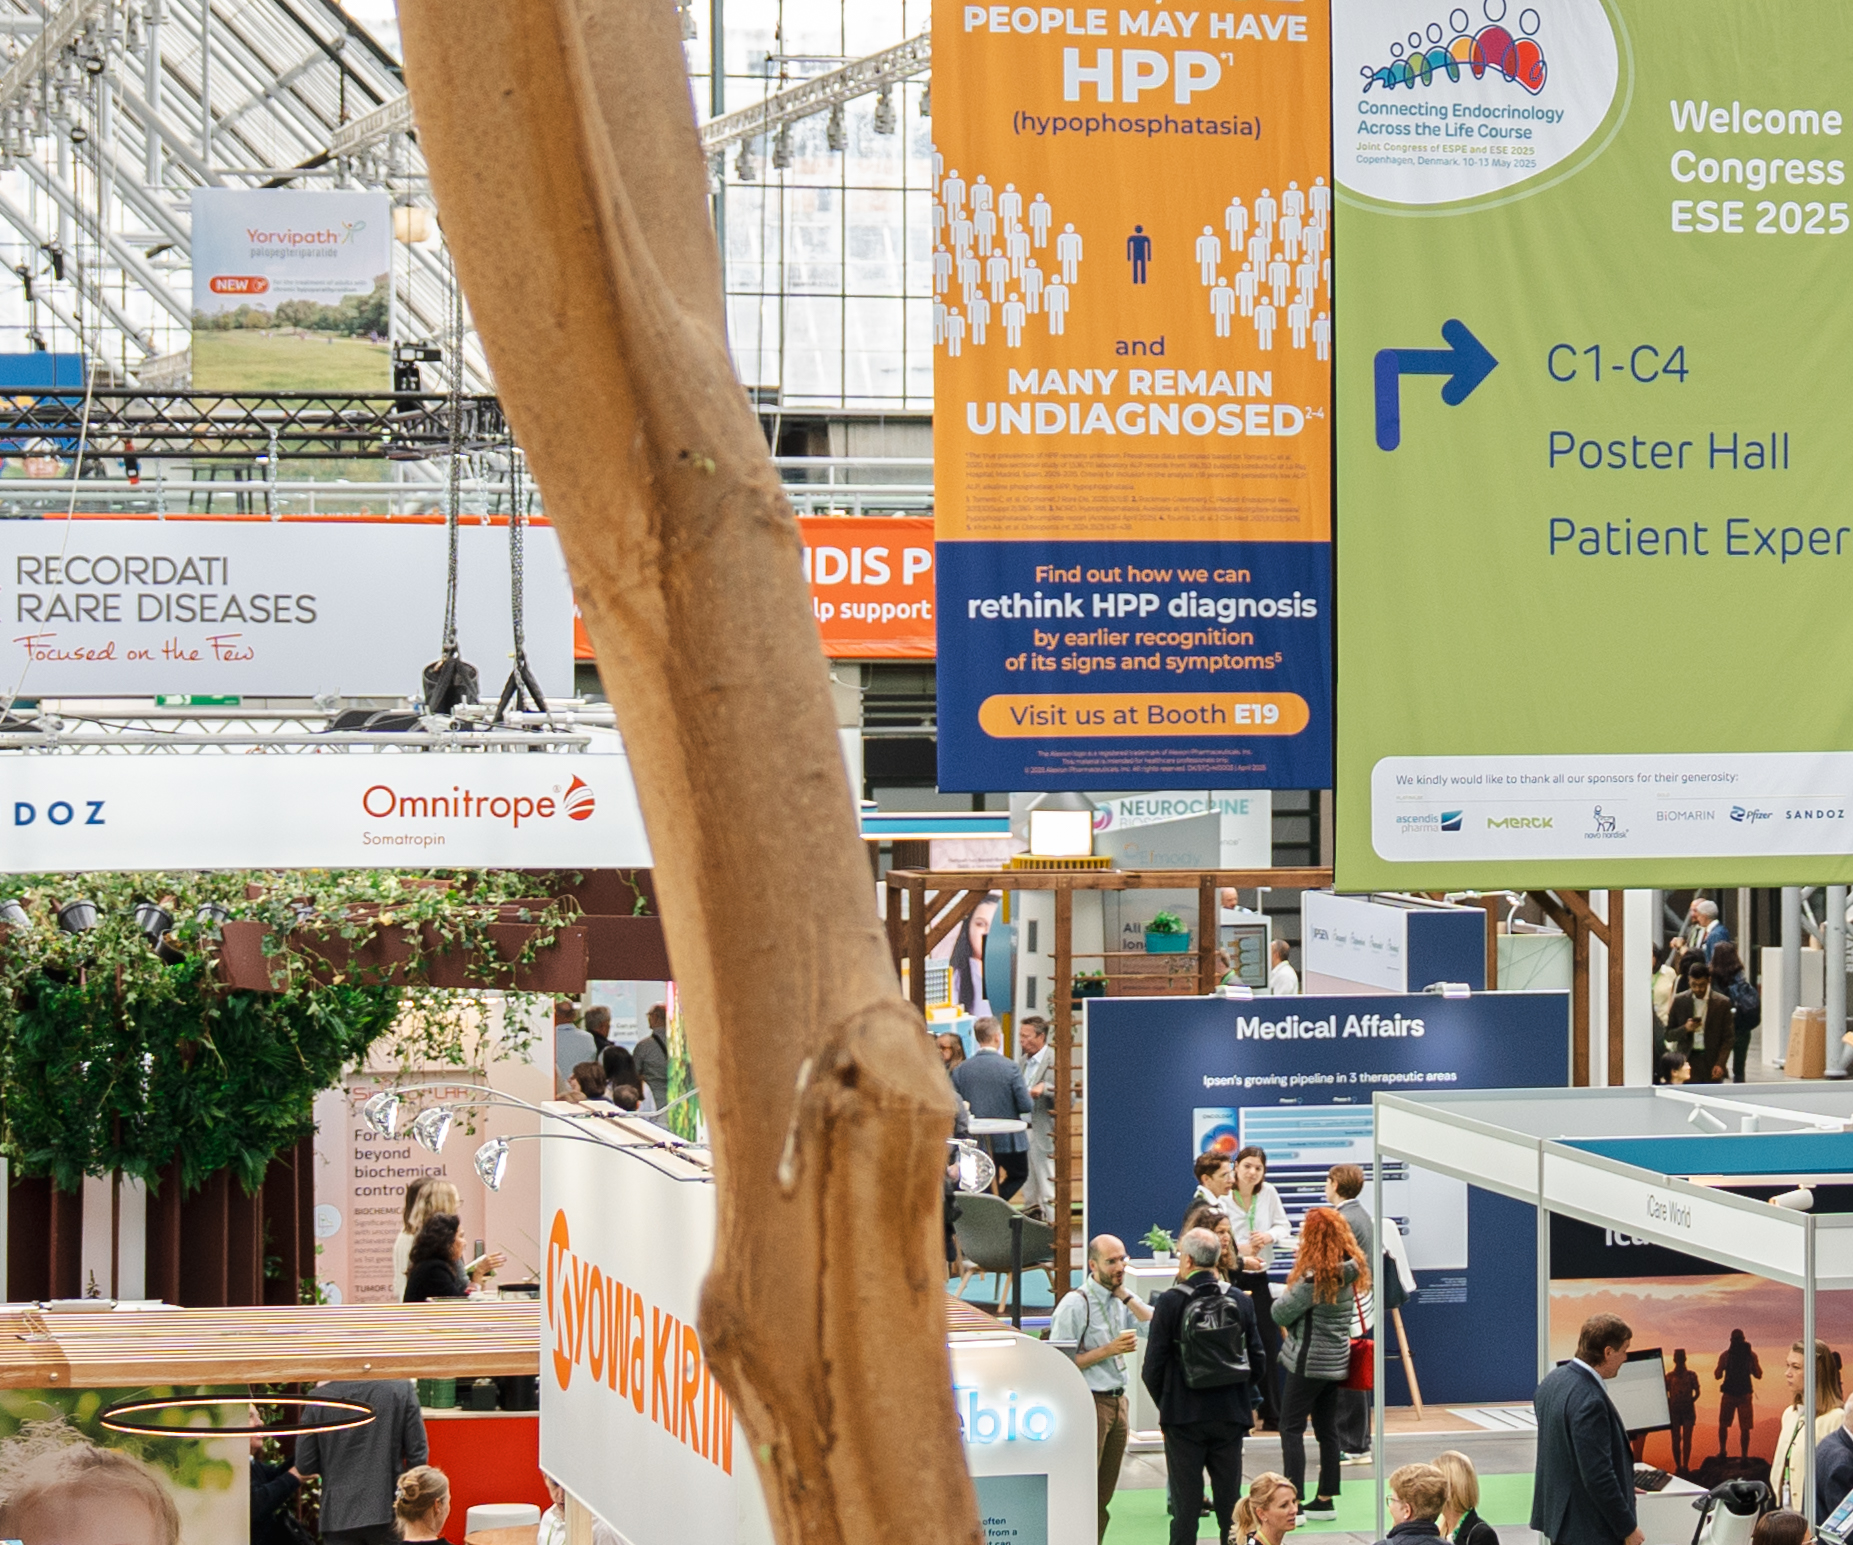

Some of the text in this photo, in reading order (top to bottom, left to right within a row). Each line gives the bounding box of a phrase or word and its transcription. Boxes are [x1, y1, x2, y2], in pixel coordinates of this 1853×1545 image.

[964, 6, 1308, 42] PEOPLE MAY HAVE
[1014, 111, 1261, 140] (hypophosphatasia)
[1358, 100, 1564, 125] Connecting Endocrinology
[1670, 100, 1842, 135] Welcome
[1357, 120, 1532, 139] Across the Life Course
[1671, 150, 1845, 191] Congress
[1672, 200, 1744, 233] ESE
[1756, 201, 1849, 234] 2025
[247, 228, 338, 246] Yorvipath
[216, 279, 249, 290] NEW
[1116, 336, 1164, 356] and
[1548, 344, 1689, 383] C1-C4
[1009, 369, 1272, 397] MANY REMAIN
[1550, 431, 1788, 469] Poster Hall
[1550, 518, 1709, 556] Patient
[17, 556, 228, 585] RECORDATI
[1036, 565, 1250, 583] Find out how we can
[18, 594, 317, 624] RARE DISEASES
[840, 600, 932, 623] support
[968, 591, 1317, 623] rethink HPP diagnosis
[13, 633, 254, 661] Focused on the Few
[1010, 704, 1279, 725] Visit us at Booth E19
[1120, 799, 1249, 816] NEUROCRINE
[1396, 814, 1439, 823] ascendis
[1746, 809, 1773, 824] Pfizer
[1786, 810, 1844, 819] SANDOZ
[363, 832, 445, 849] Somatropin
[1402, 824, 1438, 834] pharma
[1236, 1013, 1425, 1040] Medical Affairs
[1244, 1074, 1288, 1088] growing
[1290, 1073, 1334, 1087] pipeline
[1336, 1073, 1347, 1083] in
[1349, 1073, 1358, 1084] 3
[1359, 1071, 1424, 1084] therapeutic
[1426, 1070, 1457, 1083] areas
[1647, 1194, 1691, 1228] iCare World
